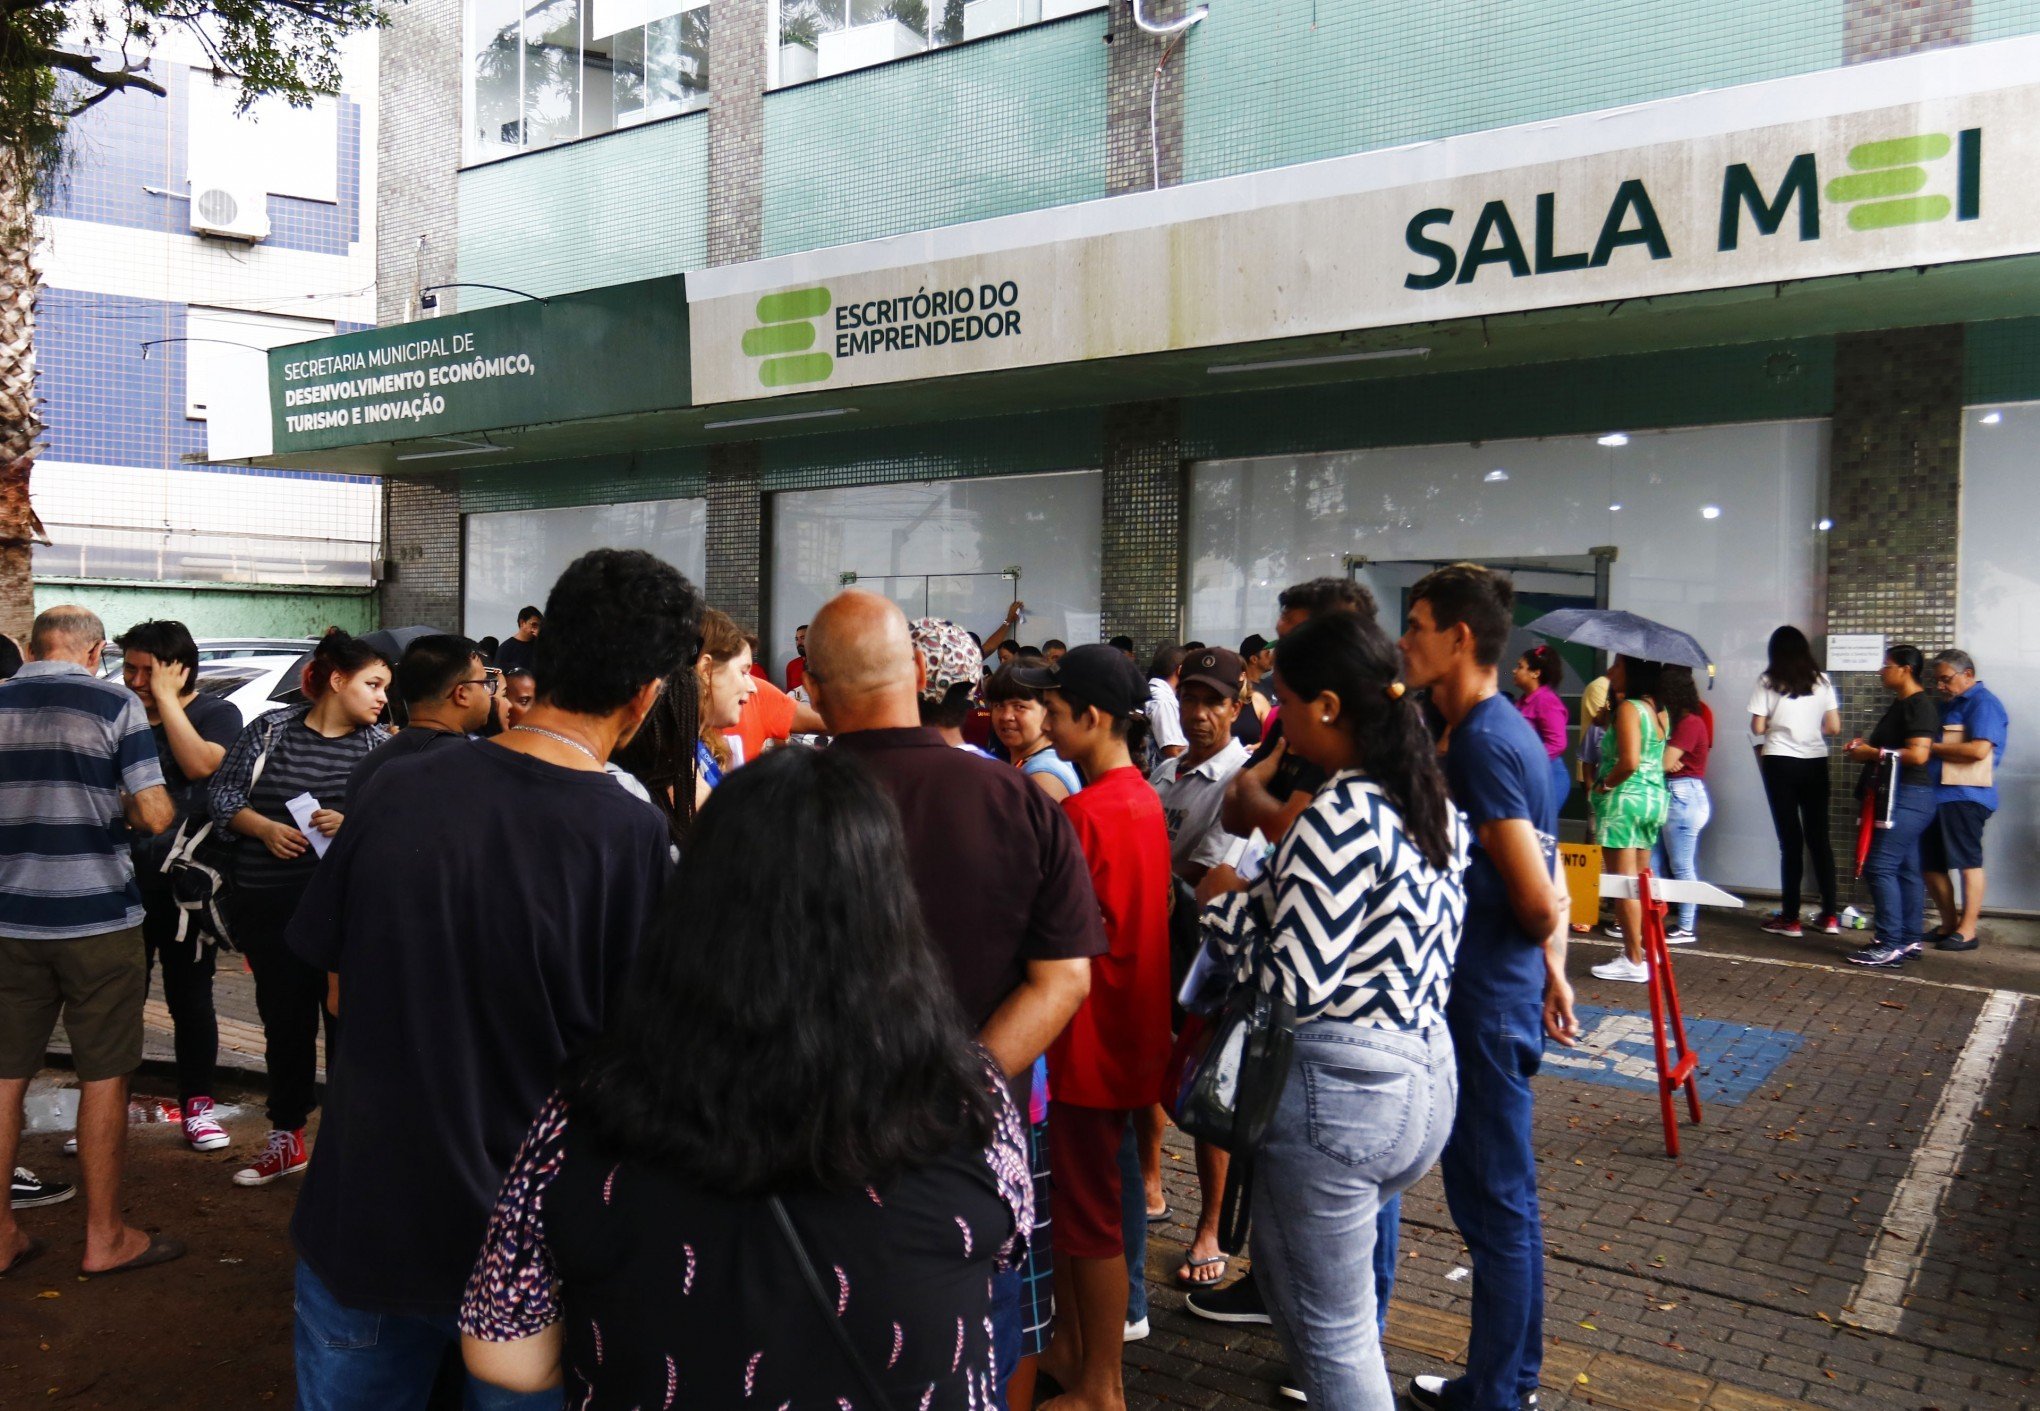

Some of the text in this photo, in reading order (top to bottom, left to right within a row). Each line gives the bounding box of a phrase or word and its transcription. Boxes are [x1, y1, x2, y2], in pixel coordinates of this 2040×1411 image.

[1403, 179, 1672, 291] SALA
[835, 281, 1018, 330] ESCRITÓRIO DO
[284, 332, 475, 381] SECRETARIA MUNICIPAL DE
[836, 311, 1021, 358] EMPRENDEDOR
[285, 353, 535, 407] DESENVOLVIMENTO ECONÔMICO,
[286, 393, 446, 433] TURISMO E INOVAÇÃO
